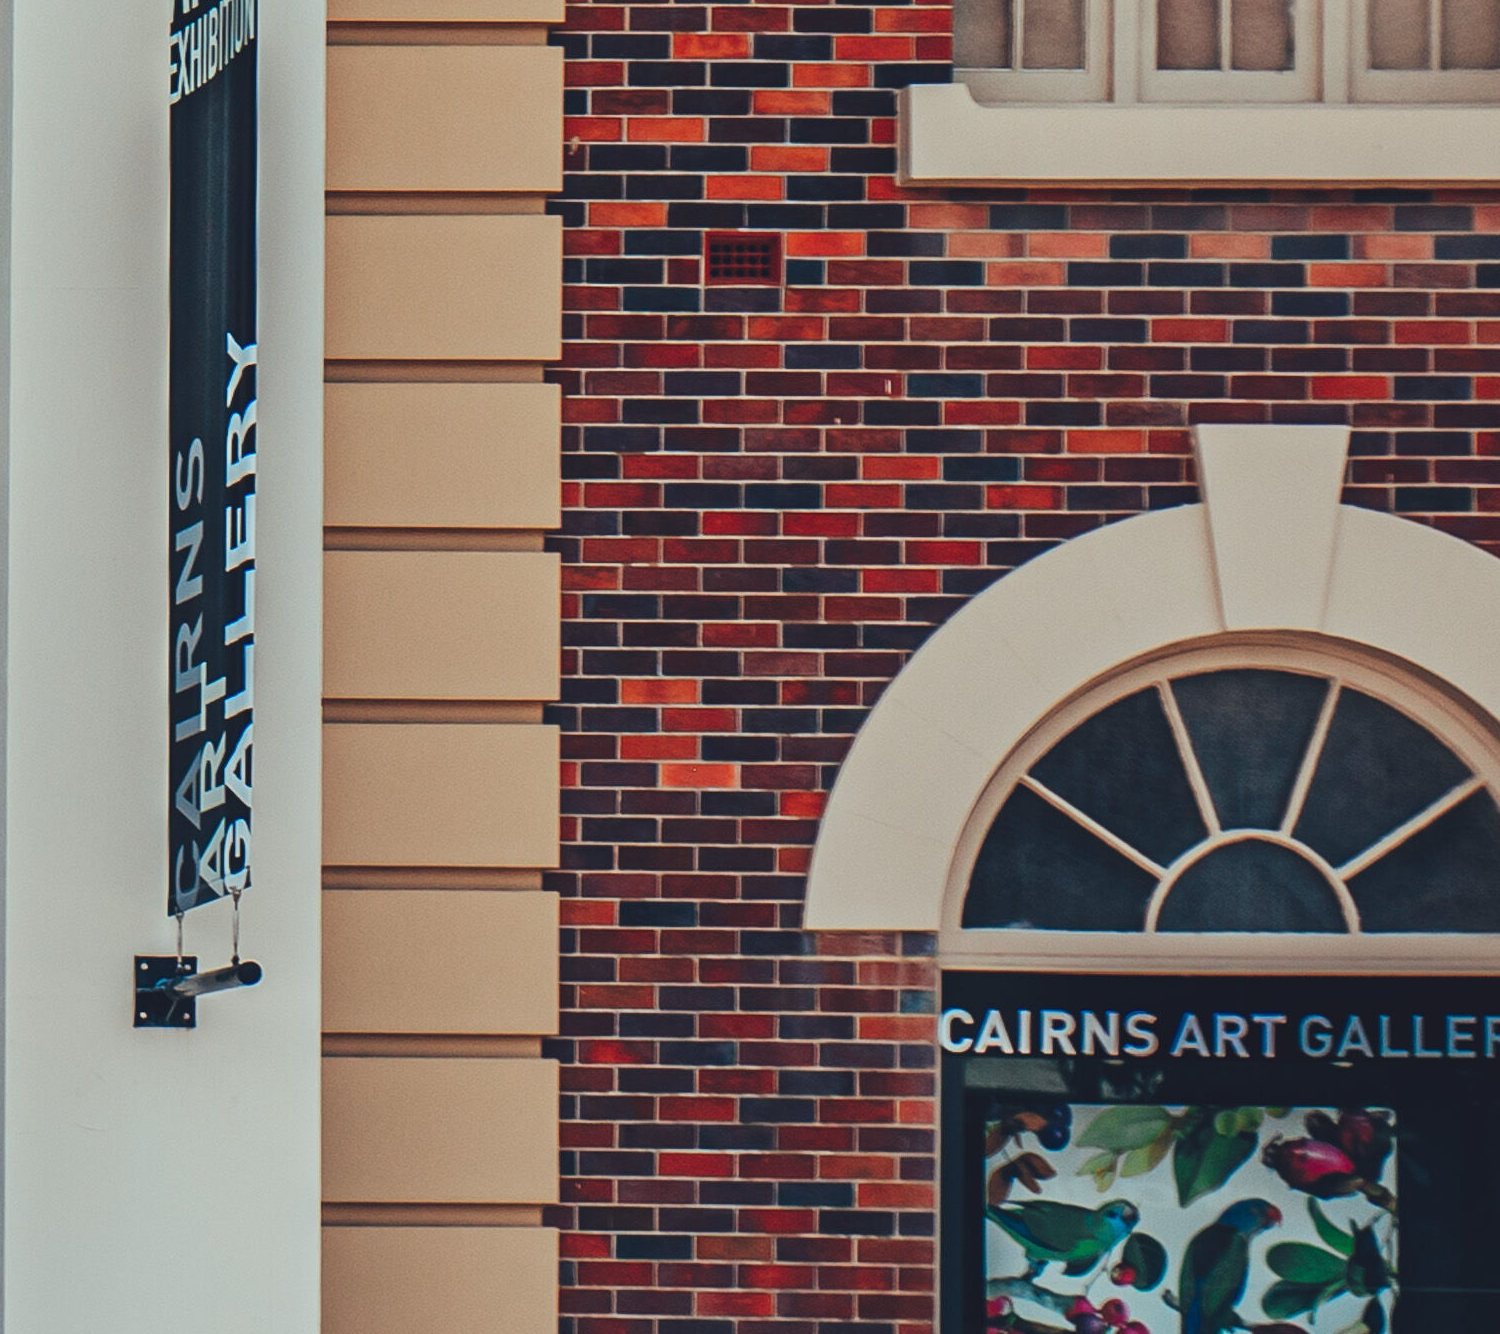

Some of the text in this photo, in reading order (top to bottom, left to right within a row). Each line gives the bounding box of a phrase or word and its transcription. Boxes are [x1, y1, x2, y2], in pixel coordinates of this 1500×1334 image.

[176, 435, 204, 913] CAIRNS
[200, 661, 227, 898] ART
[225, 331, 257, 894] GALLERY
[938, 1008, 1159, 1055] CAIRNS
[1171, 1012, 1287, 1058] ART
